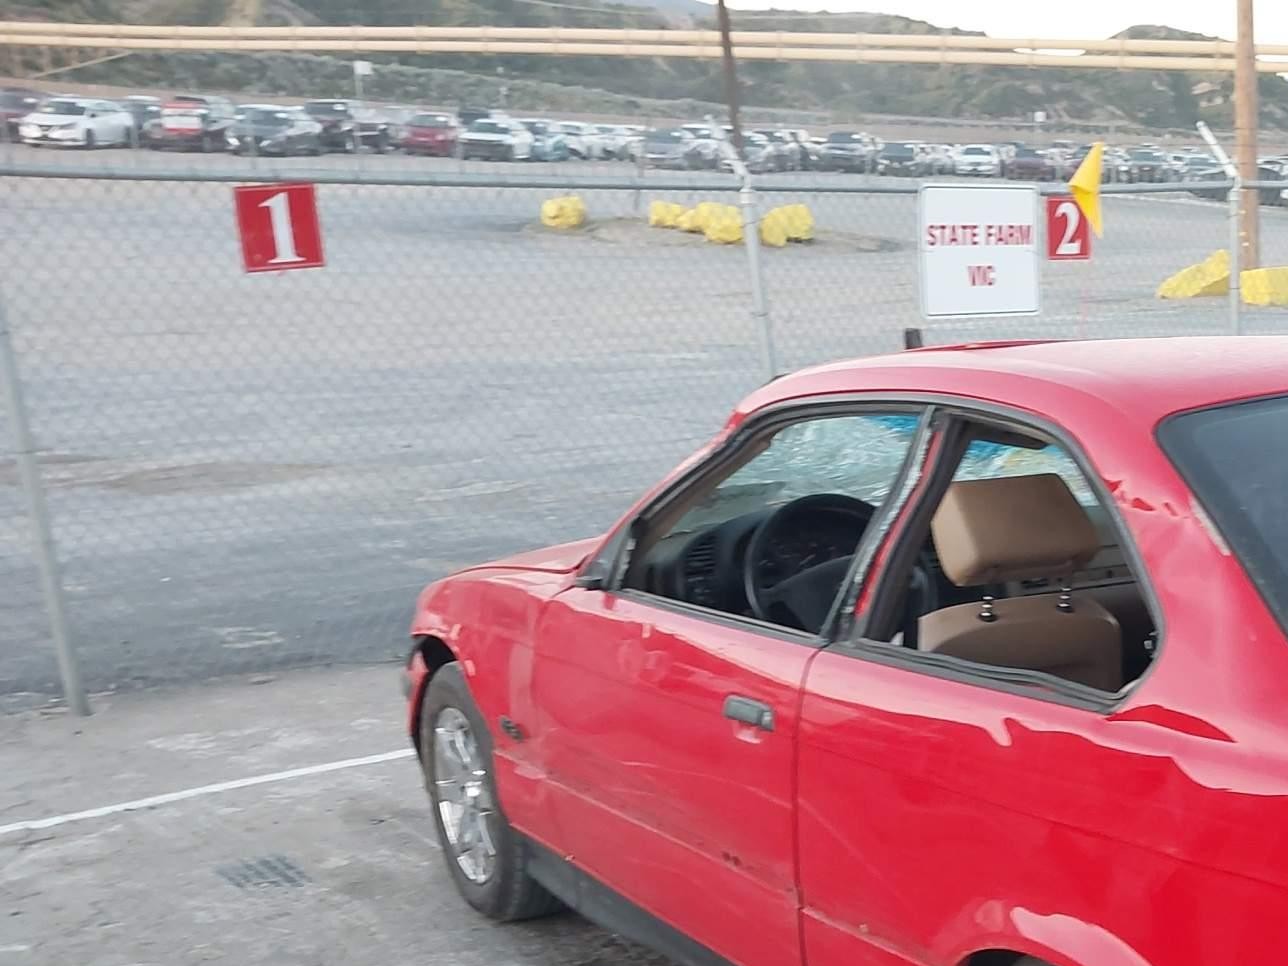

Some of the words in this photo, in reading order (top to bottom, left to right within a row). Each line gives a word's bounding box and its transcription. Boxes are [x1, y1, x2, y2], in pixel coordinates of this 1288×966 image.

[258, 191, 307, 264] 1
[927, 224, 979, 246] STATE
[985, 224, 1034, 246] FARM
[1055, 202, 1082, 255] 2
